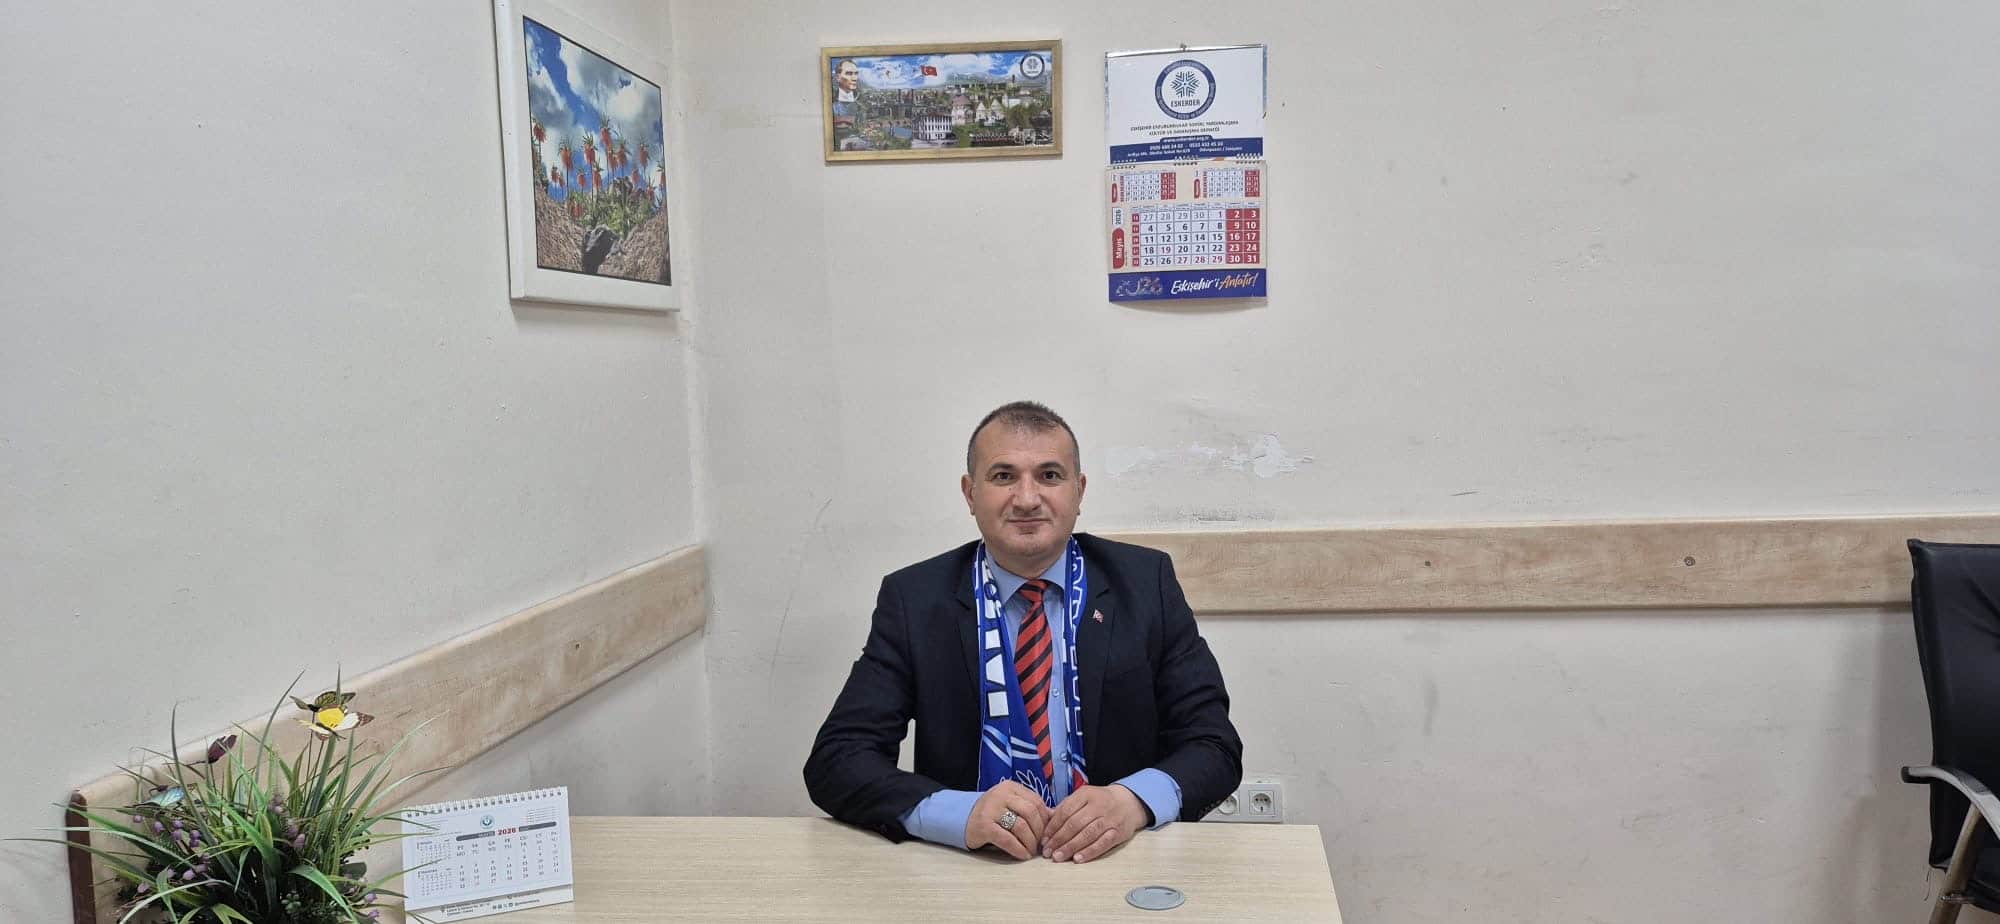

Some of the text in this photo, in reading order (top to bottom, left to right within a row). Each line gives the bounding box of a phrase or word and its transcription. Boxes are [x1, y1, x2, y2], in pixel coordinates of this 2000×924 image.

[1234, 210, 1240, 218] 2
[1199, 222, 1205, 230] 7
[1162, 246, 1171, 254] 19
[1229, 255, 1240, 263] 30
